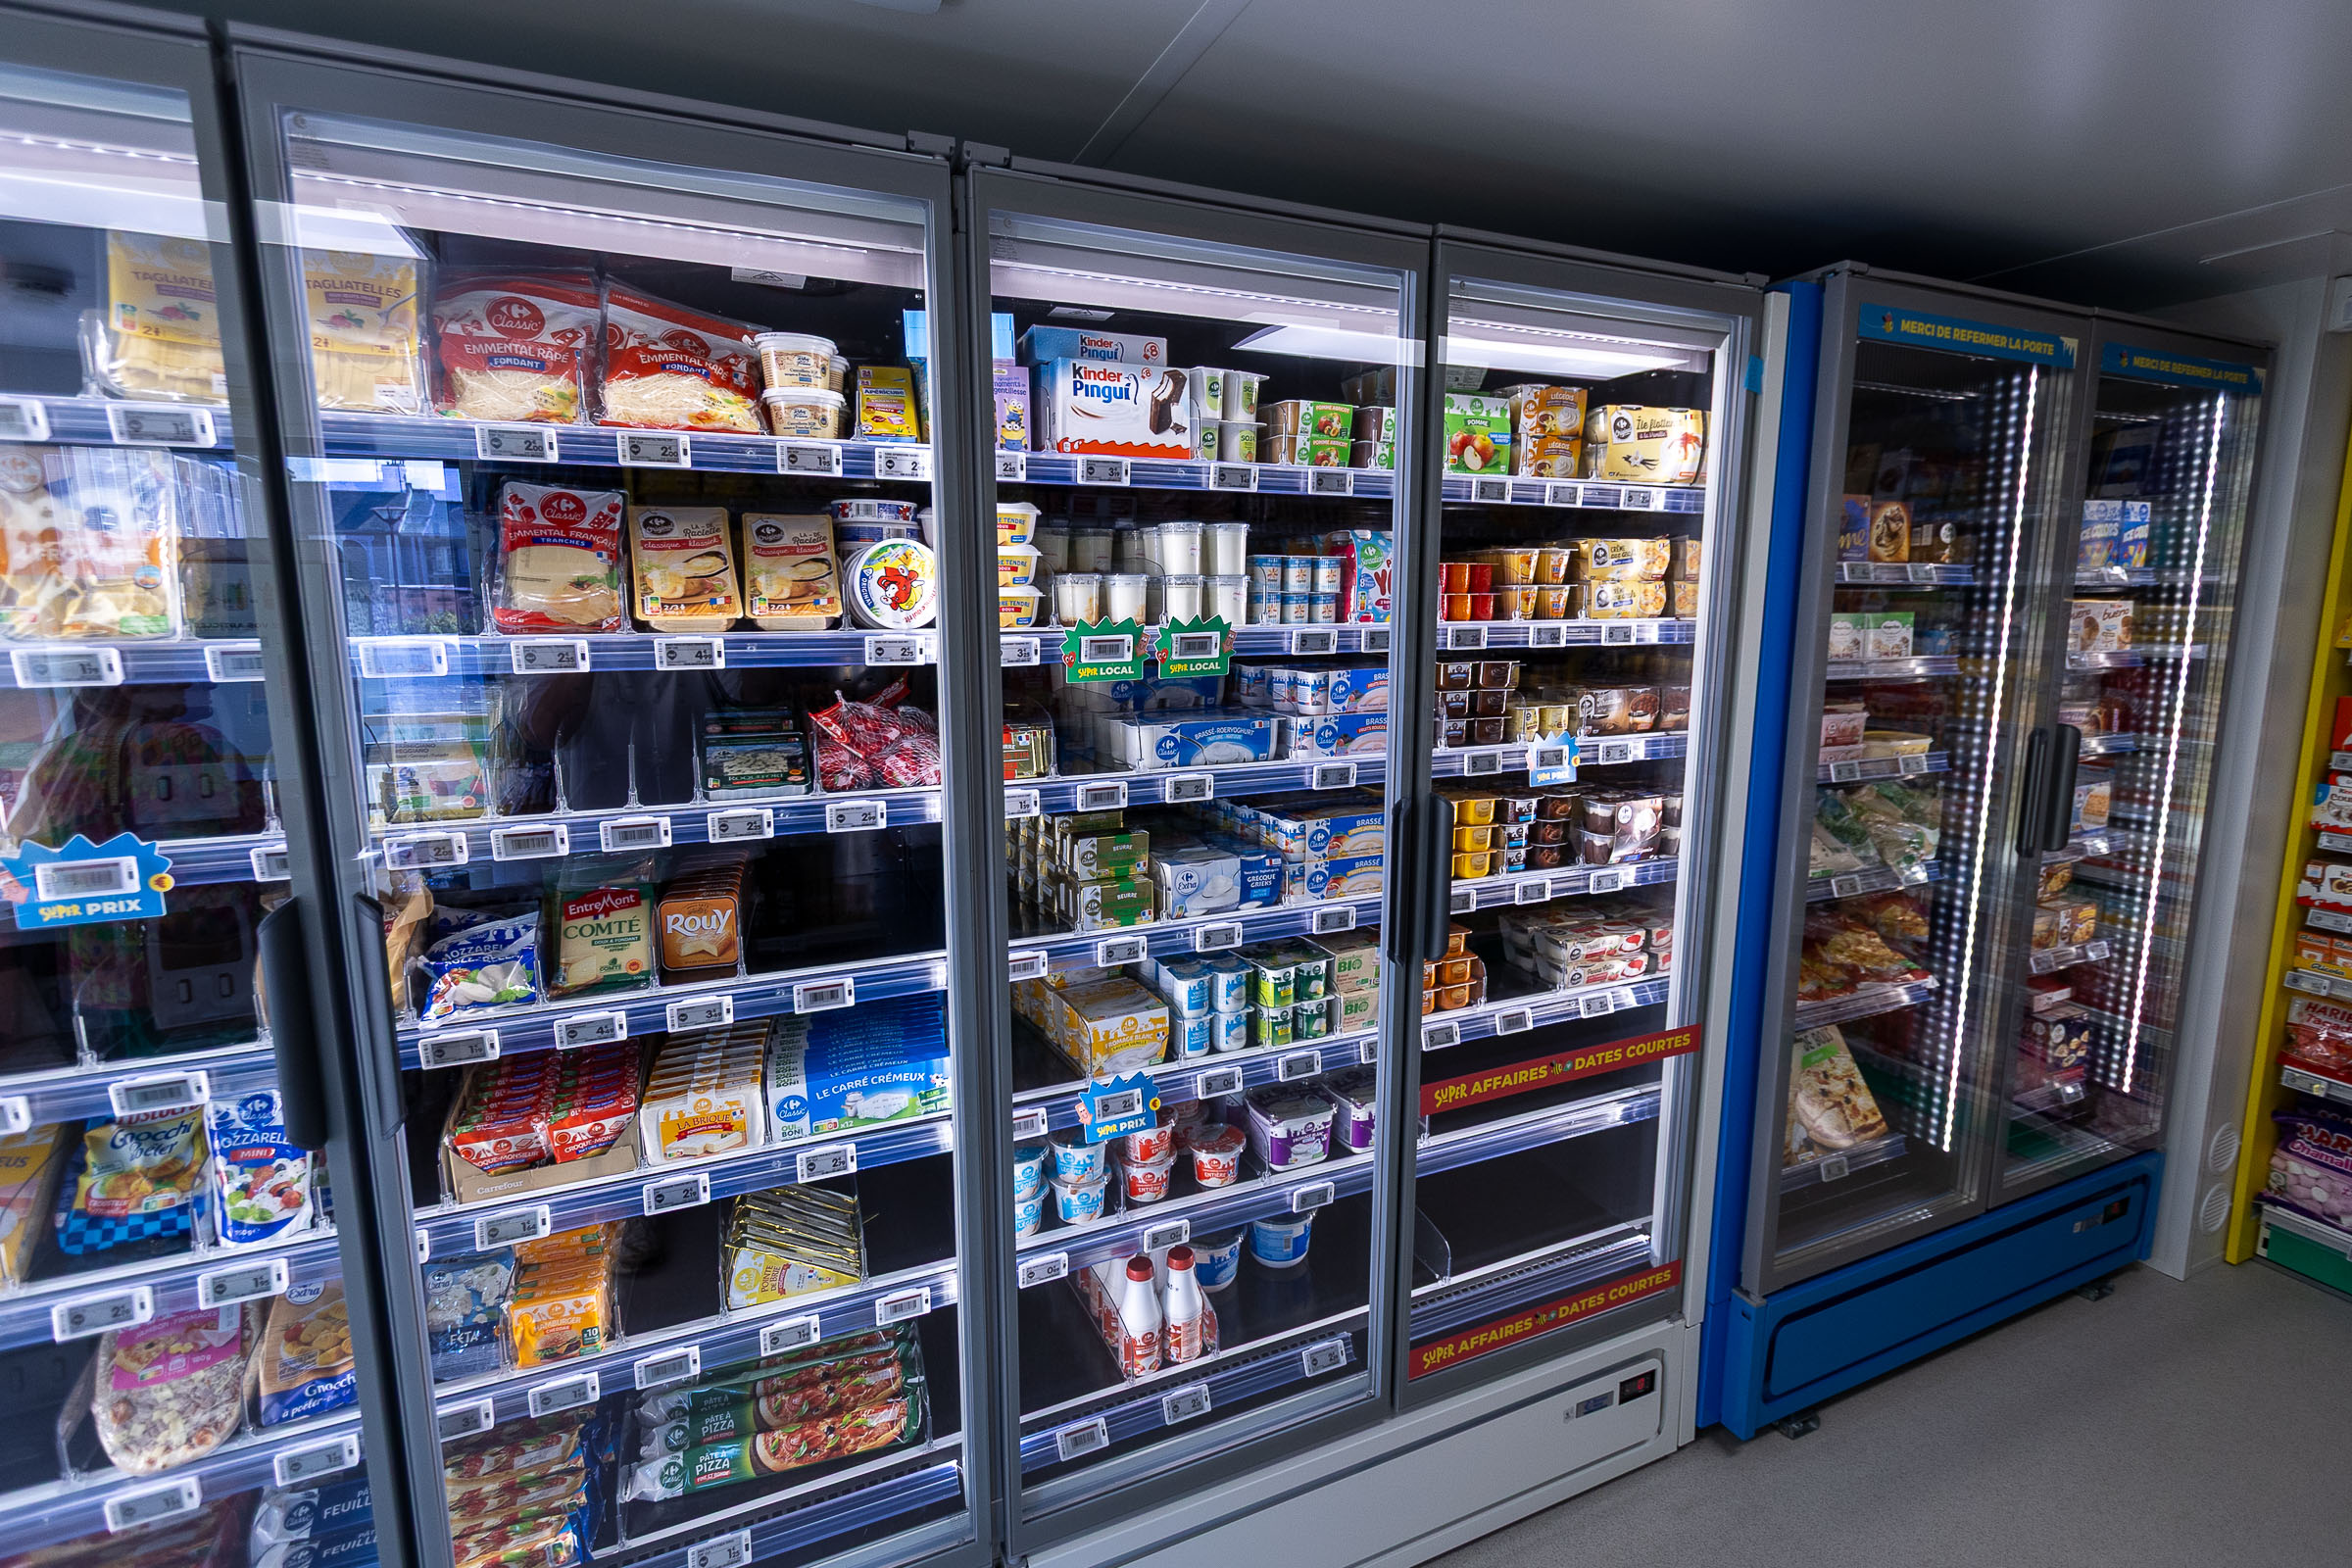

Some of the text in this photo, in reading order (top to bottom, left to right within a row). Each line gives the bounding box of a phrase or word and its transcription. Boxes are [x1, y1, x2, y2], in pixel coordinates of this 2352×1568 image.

[130, 270, 216, 291] TAGLIATE
[491, 314, 540, 332] Classic
[1080, 334, 1113, 348] Kinder
[1900, 318, 2055, 356] MERCI DE REFERMER LA PORTE
[464, 343, 570, 364] EMMENTAL RÂPÉ
[639, 353, 703, 368] EMMENTAL
[493, 357, 541, 368] FONDANT
[665, 364, 708, 376] FONDANT
[2132, 355, 2249, 384] MERCI DE REFERMER LA PORTE
[1072, 363, 1122, 383] Kinder
[1466, 418, 1489, 427] POMME
[543, 508, 584, 521] Classic
[509, 528, 617, 550] EMMENTAL FRANÇAIS
[683, 526, 722, 539] Raclette
[792, 535, 828, 546] Raclette
[540, 537, 586, 547] TRANCHES
[861, 577, 874, 609] ORIGINAL
[1100, 665, 1135, 676] LOCAL
[1189, 662, 1221, 671] LOCAL
[1177, 880, 1198, 891] Extra
[1247, 873, 1276, 883] GRECQUE
[86, 899, 142, 915] PRIX
[564, 915, 641, 940] COMTÉ
[1337, 958, 1362, 972] BIO
[2311, 962, 2345, 976] Ricola
[1344, 1003, 1369, 1015] BIO
[1104, 1032, 1153, 1049] FROMAGE BLANC
[1434, 1033, 1690, 1108] SUPER AFFAIRES DATES COURTES
[815, 1072, 925, 1101] LE CARRÉ CRÉMEUX
[779, 1106, 808, 1118] Classic
[677, 1114, 731, 1130] LA BRIQUE
[1119, 1116, 1147, 1131] PRIX
[110, 1118, 195, 1151] Gnocchi
[220, 1132, 292, 1148] OZZARELL
[564, 1134, 619, 1153] CROQUE-MONS
[239, 1150, 268, 1158] MINI
[472, 1151, 539, 1167] ROQUE-MONSIEUR
[2288, 1139, 2352, 1171] Chamall
[477, 1179, 524, 1195] Carrefour
[760, 1264, 774, 1294] POINTE
[769, 1265, 782, 1282] BRIE
[1422, 1268, 1672, 1370] SUPER AFFAIRES DATES COURTES
[449, 1329, 480, 1346] FETA
[304, 1374, 356, 1397] Gnocch
[705, 1414, 724, 1425] PÂTE
[701, 1419, 735, 1437] PIZZA
[699, 1451, 720, 1463] PÂTE
[695, 1458, 730, 1476] PIZZA
[323, 1495, 372, 1519] FEUILL
[322, 1532, 378, 1559] FEUILL
